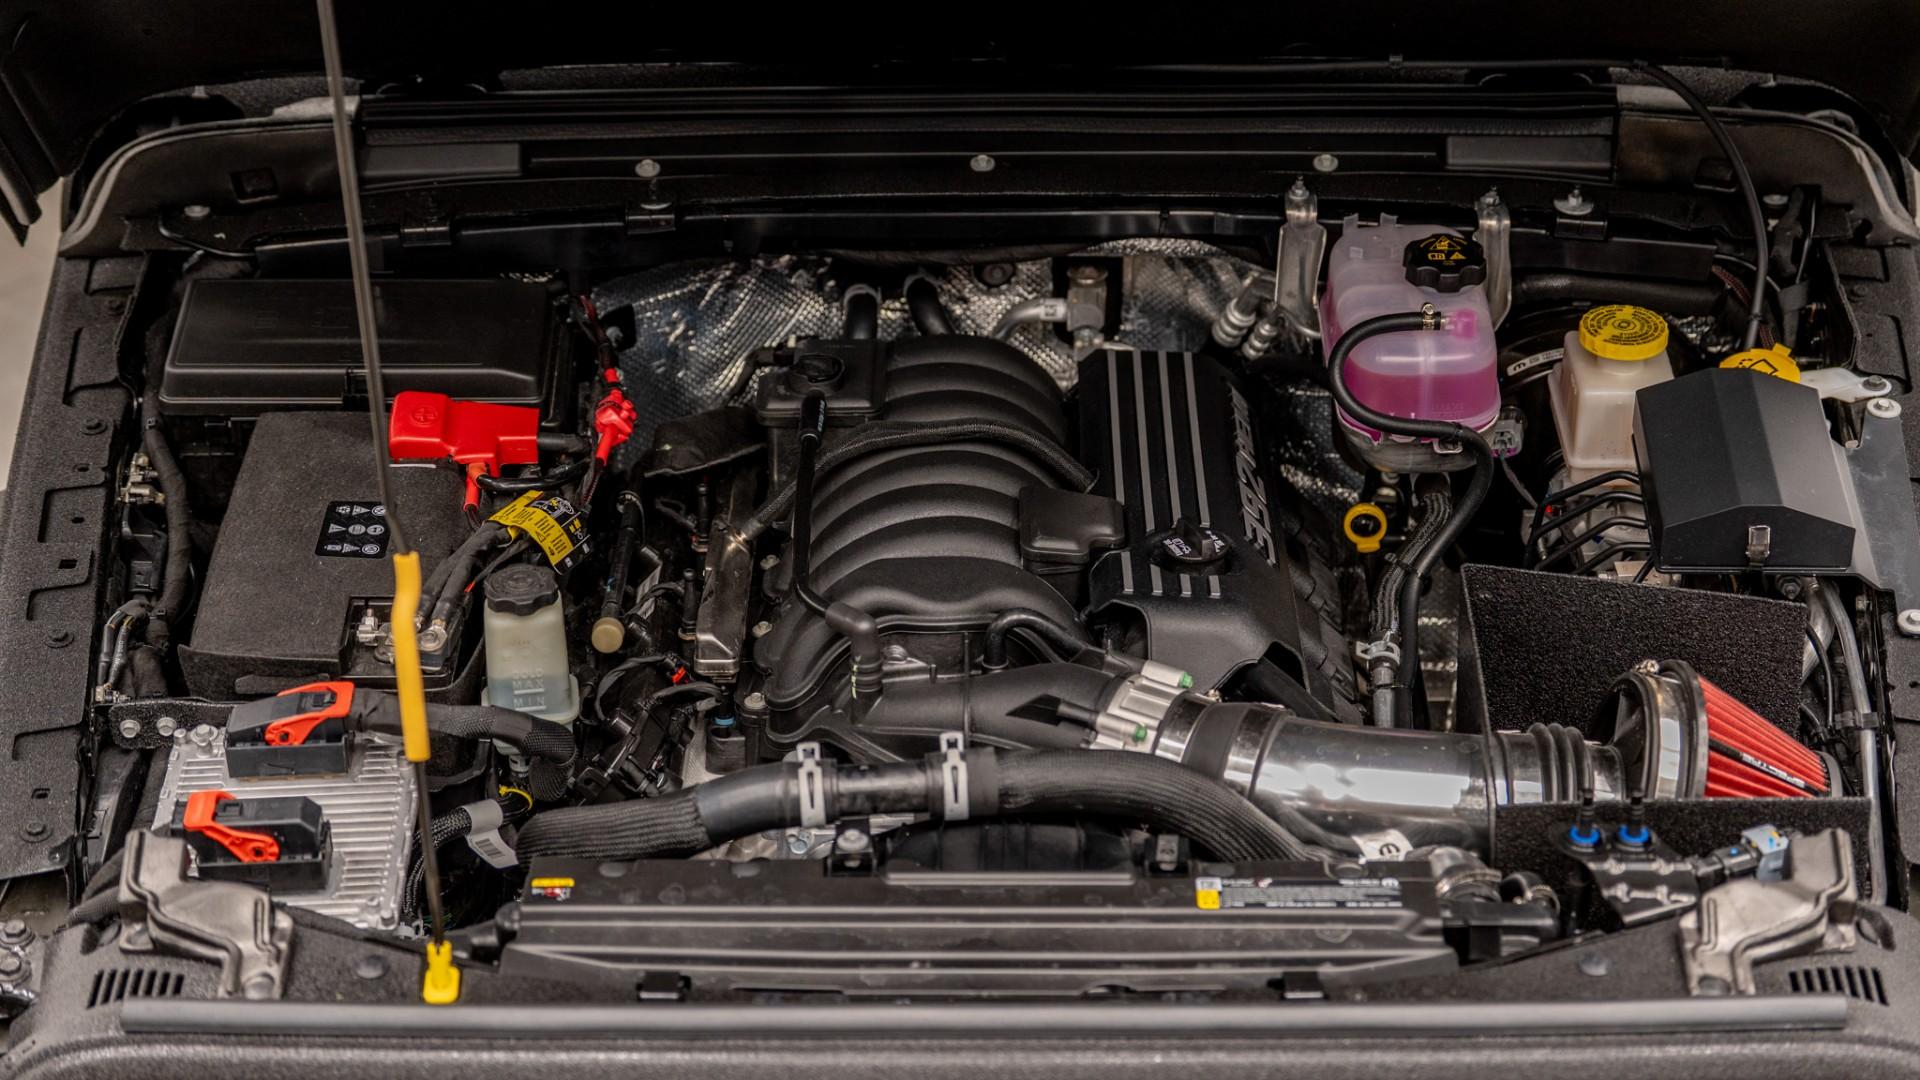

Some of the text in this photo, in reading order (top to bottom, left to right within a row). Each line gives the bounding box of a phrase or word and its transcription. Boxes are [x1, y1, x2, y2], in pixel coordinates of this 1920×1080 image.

[1236, 450, 1277, 565] 392
[512, 679, 544, 690] MAX
[513, 696, 545, 709] MIN
